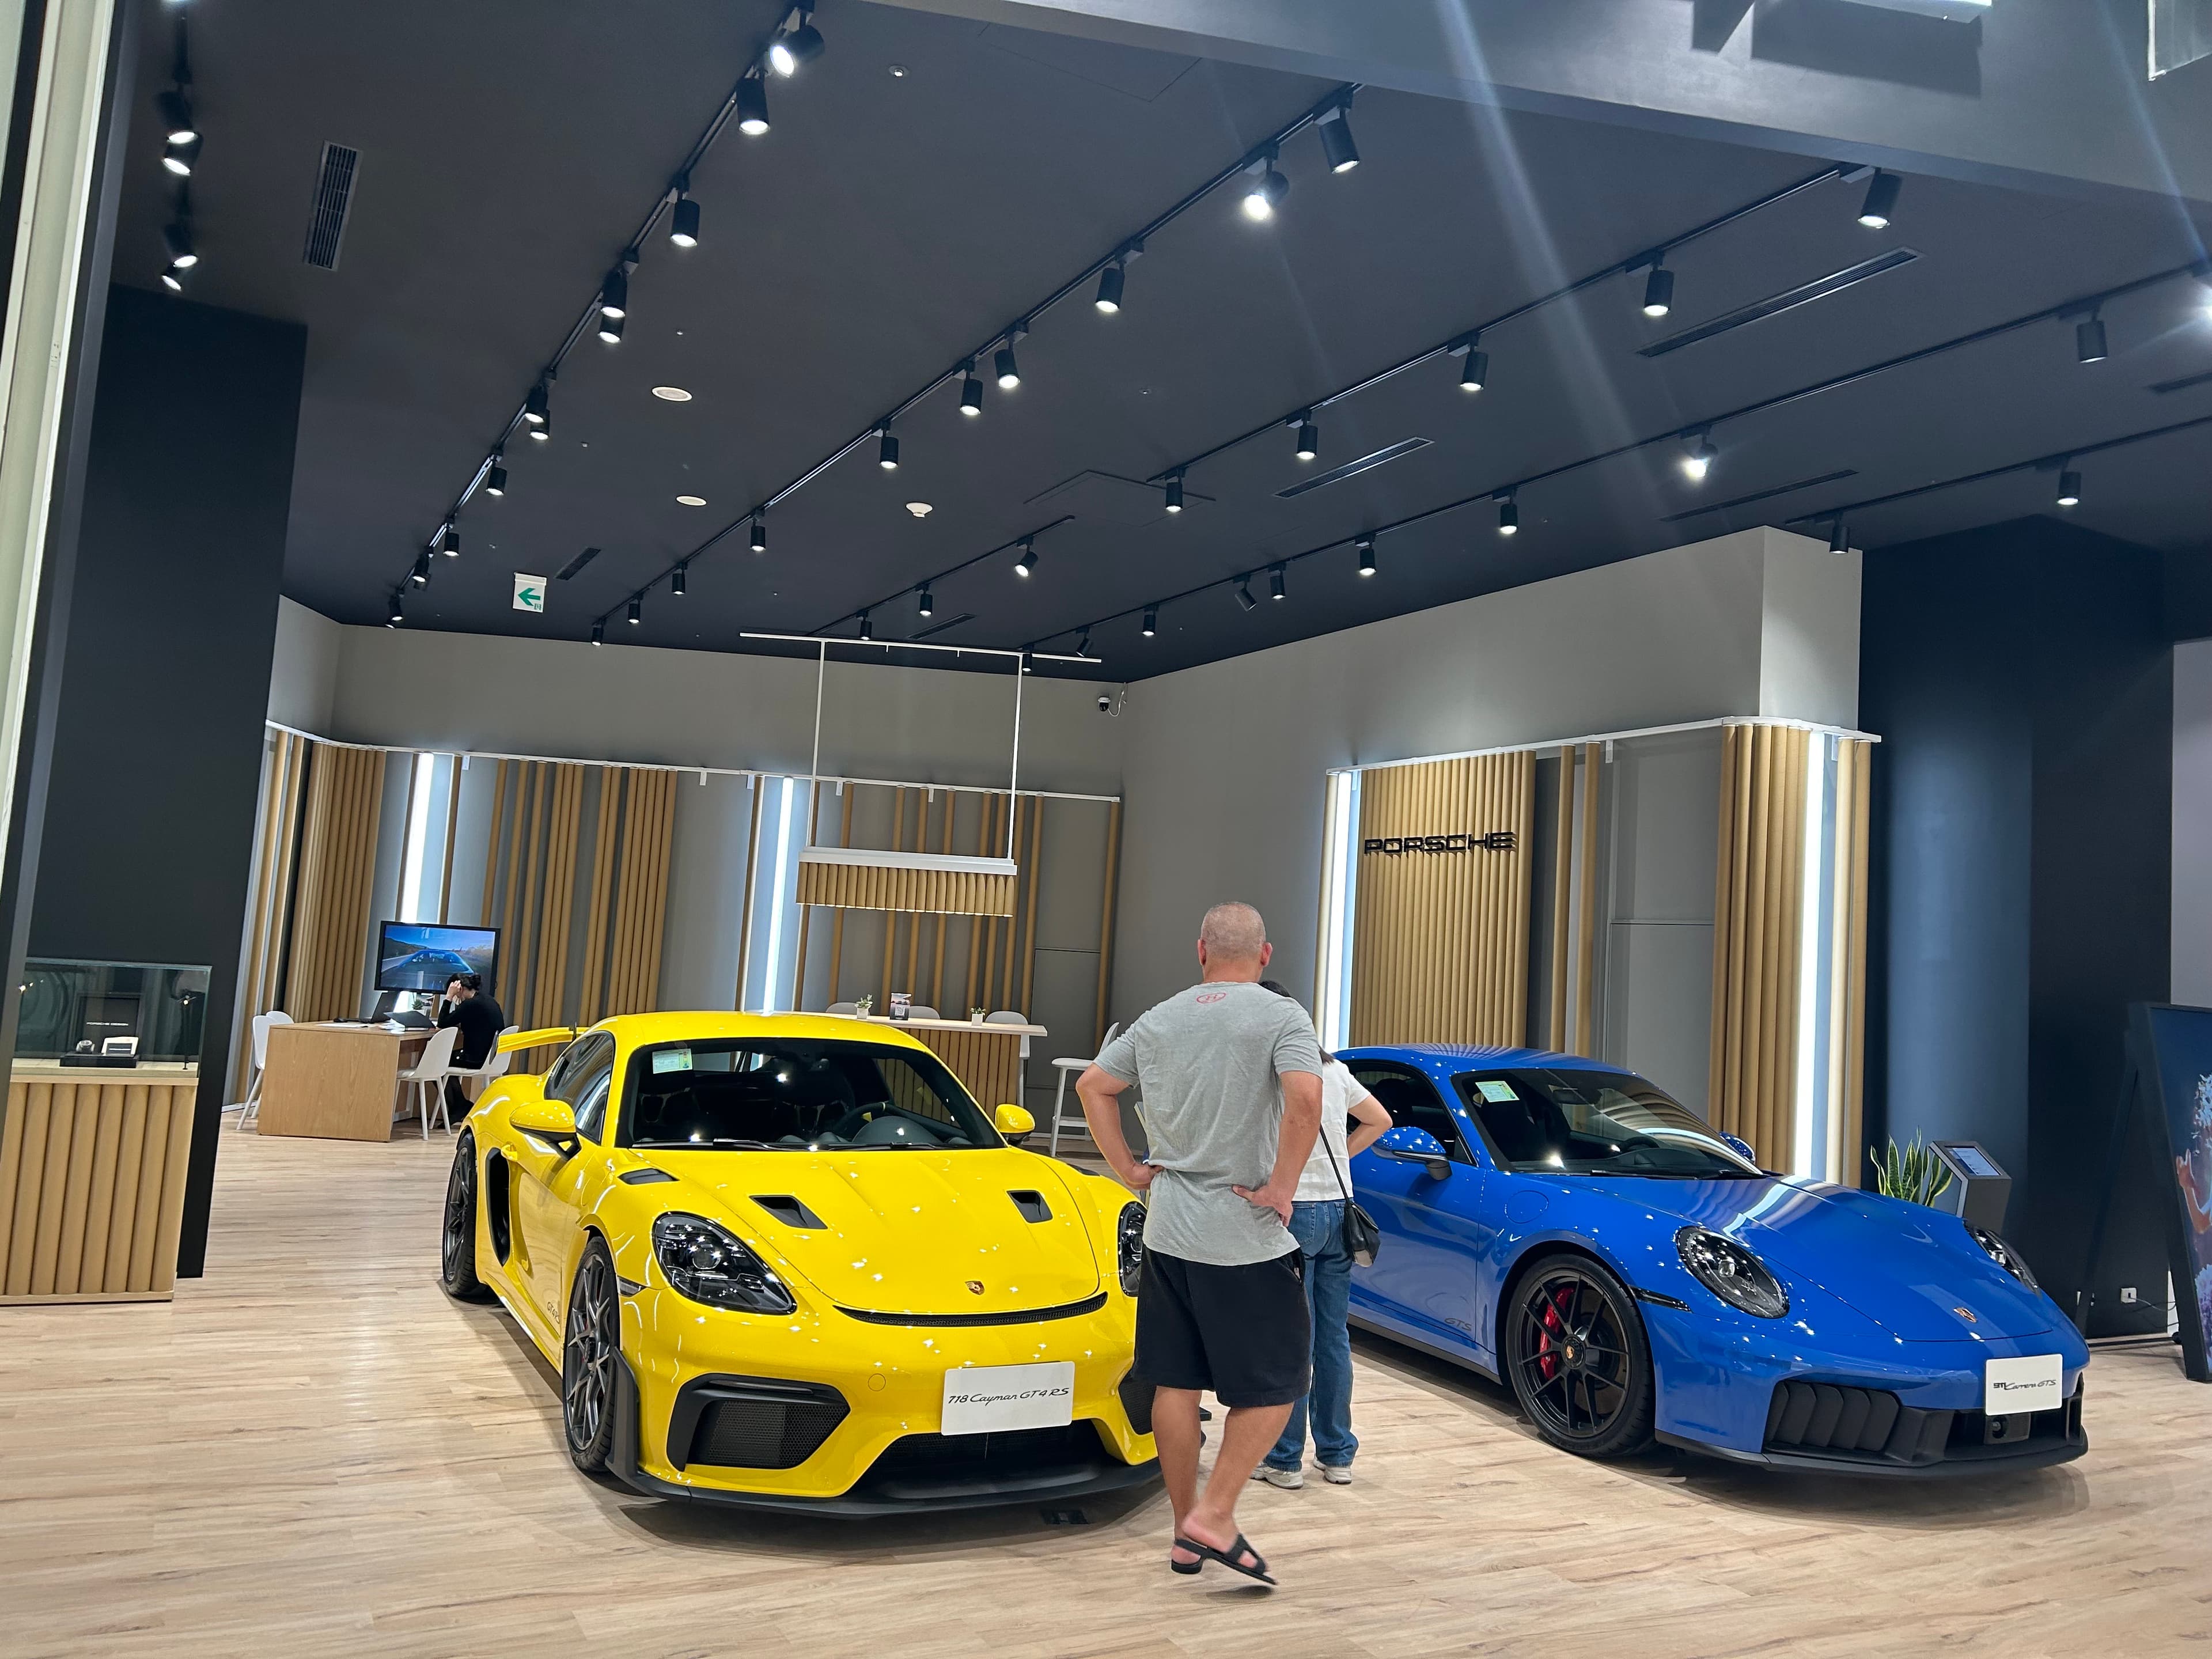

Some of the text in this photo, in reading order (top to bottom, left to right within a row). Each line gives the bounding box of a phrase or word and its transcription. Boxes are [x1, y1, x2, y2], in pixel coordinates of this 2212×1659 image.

[1364, 832, 1513, 854] PORSCHE
[1444, 1317, 1472, 1331] GTS
[948, 1395, 969, 1404] 718
[970, 1394, 1017, 1406] Cayman
[1048, 1388, 1069, 1396] RS
